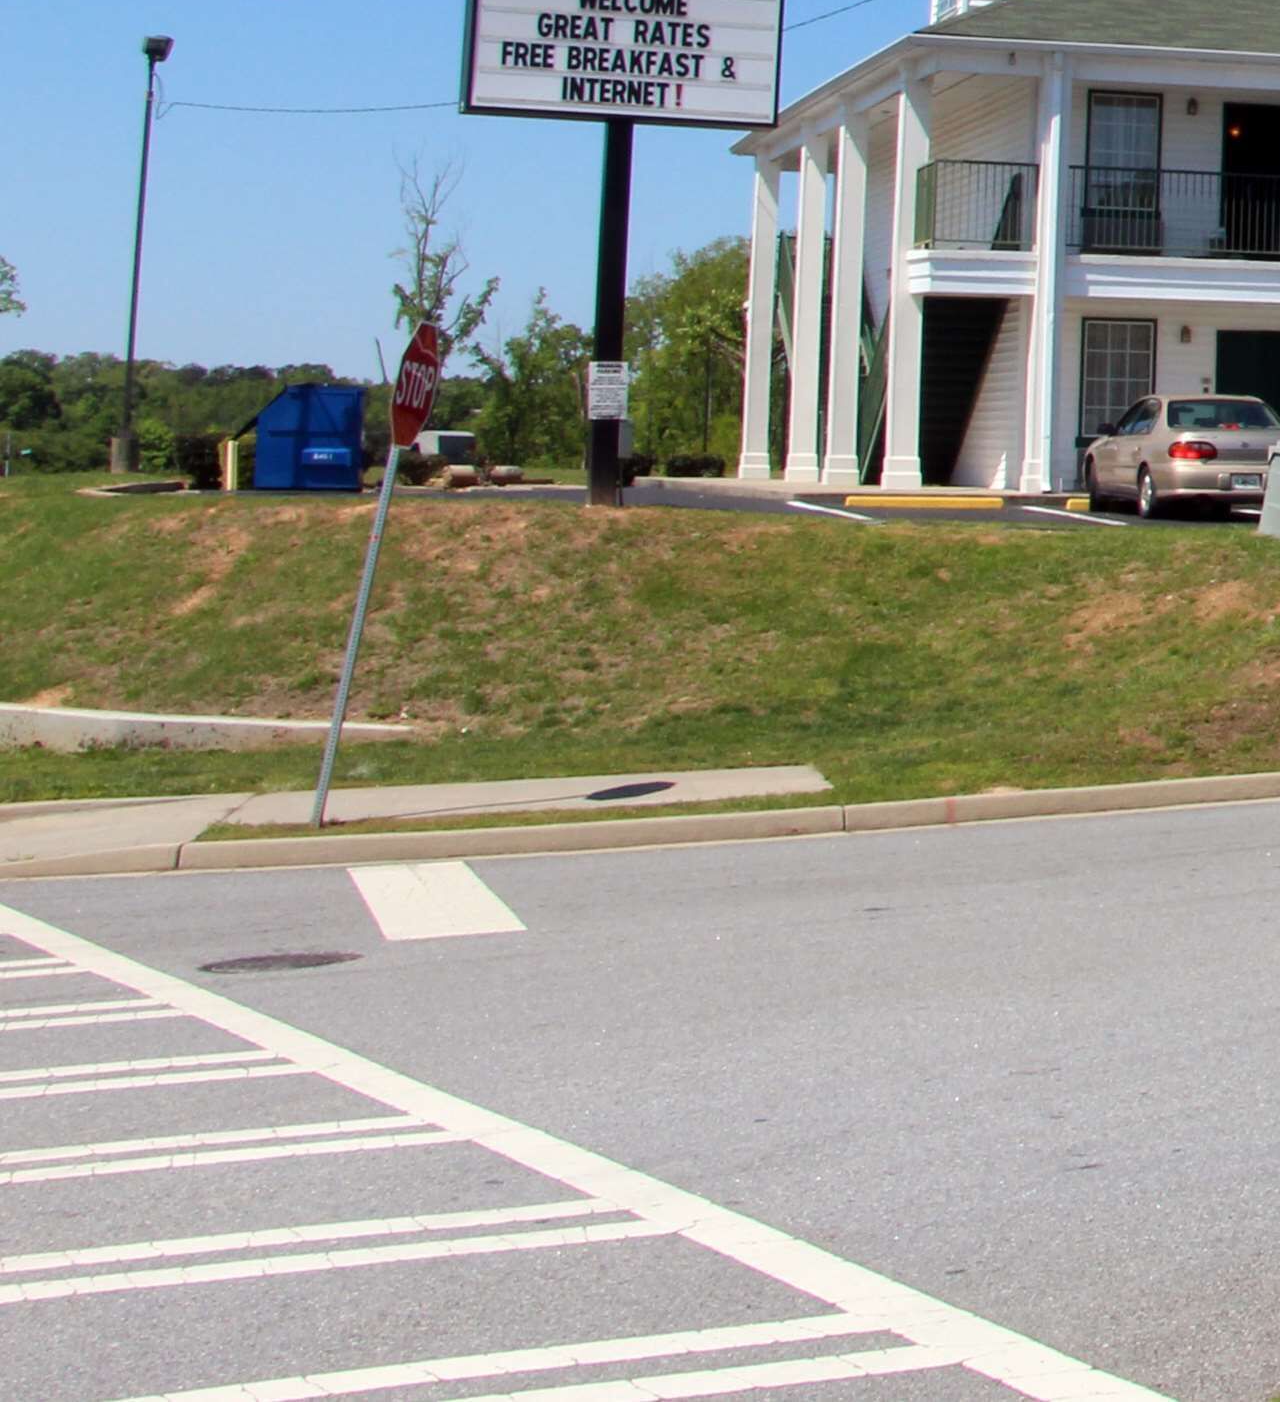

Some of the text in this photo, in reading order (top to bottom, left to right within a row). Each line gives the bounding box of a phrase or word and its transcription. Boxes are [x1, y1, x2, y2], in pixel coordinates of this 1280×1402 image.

[537, 13, 711, 48] GREAT RATES
[501, 41, 736, 80] FREE BREAKFAST &
[396, 360, 436, 409] STOP
